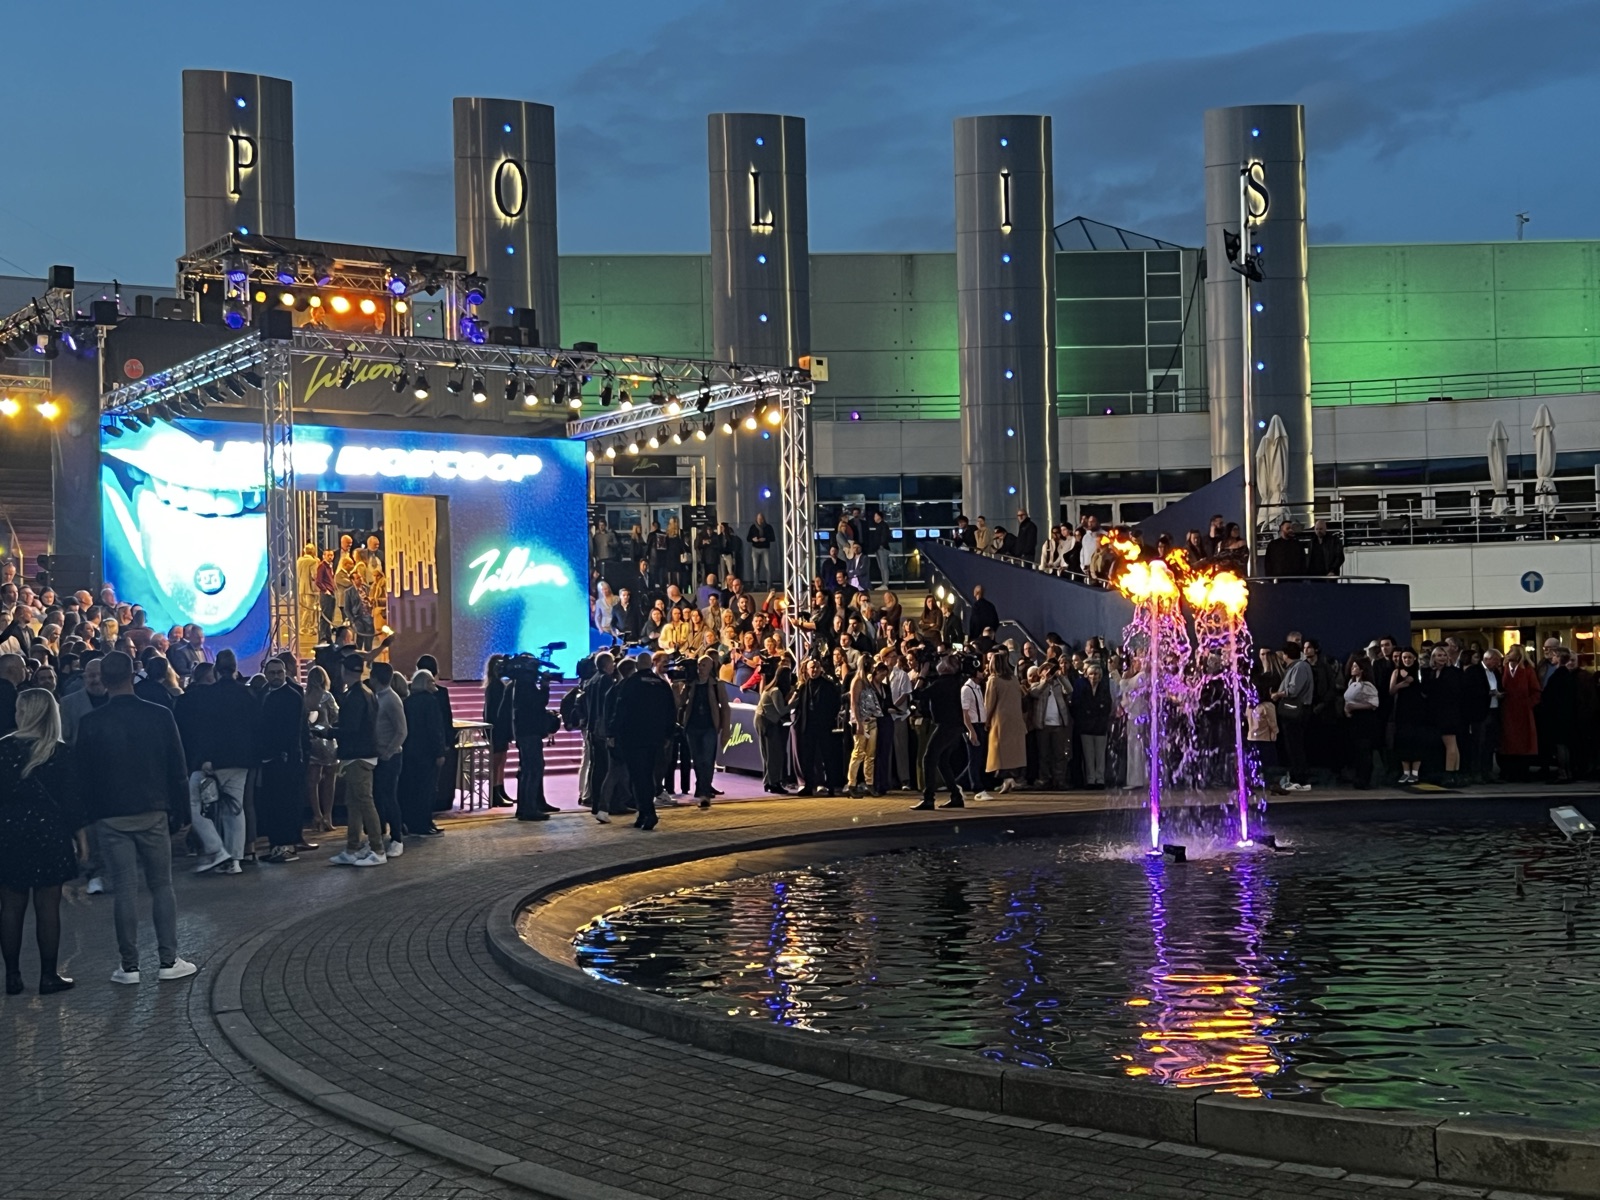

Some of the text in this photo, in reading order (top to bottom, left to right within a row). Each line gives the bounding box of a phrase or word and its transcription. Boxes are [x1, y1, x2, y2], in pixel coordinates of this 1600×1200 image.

[228, 134, 1270, 229] P O L I S
[468, 547, 568, 606] Zillion
